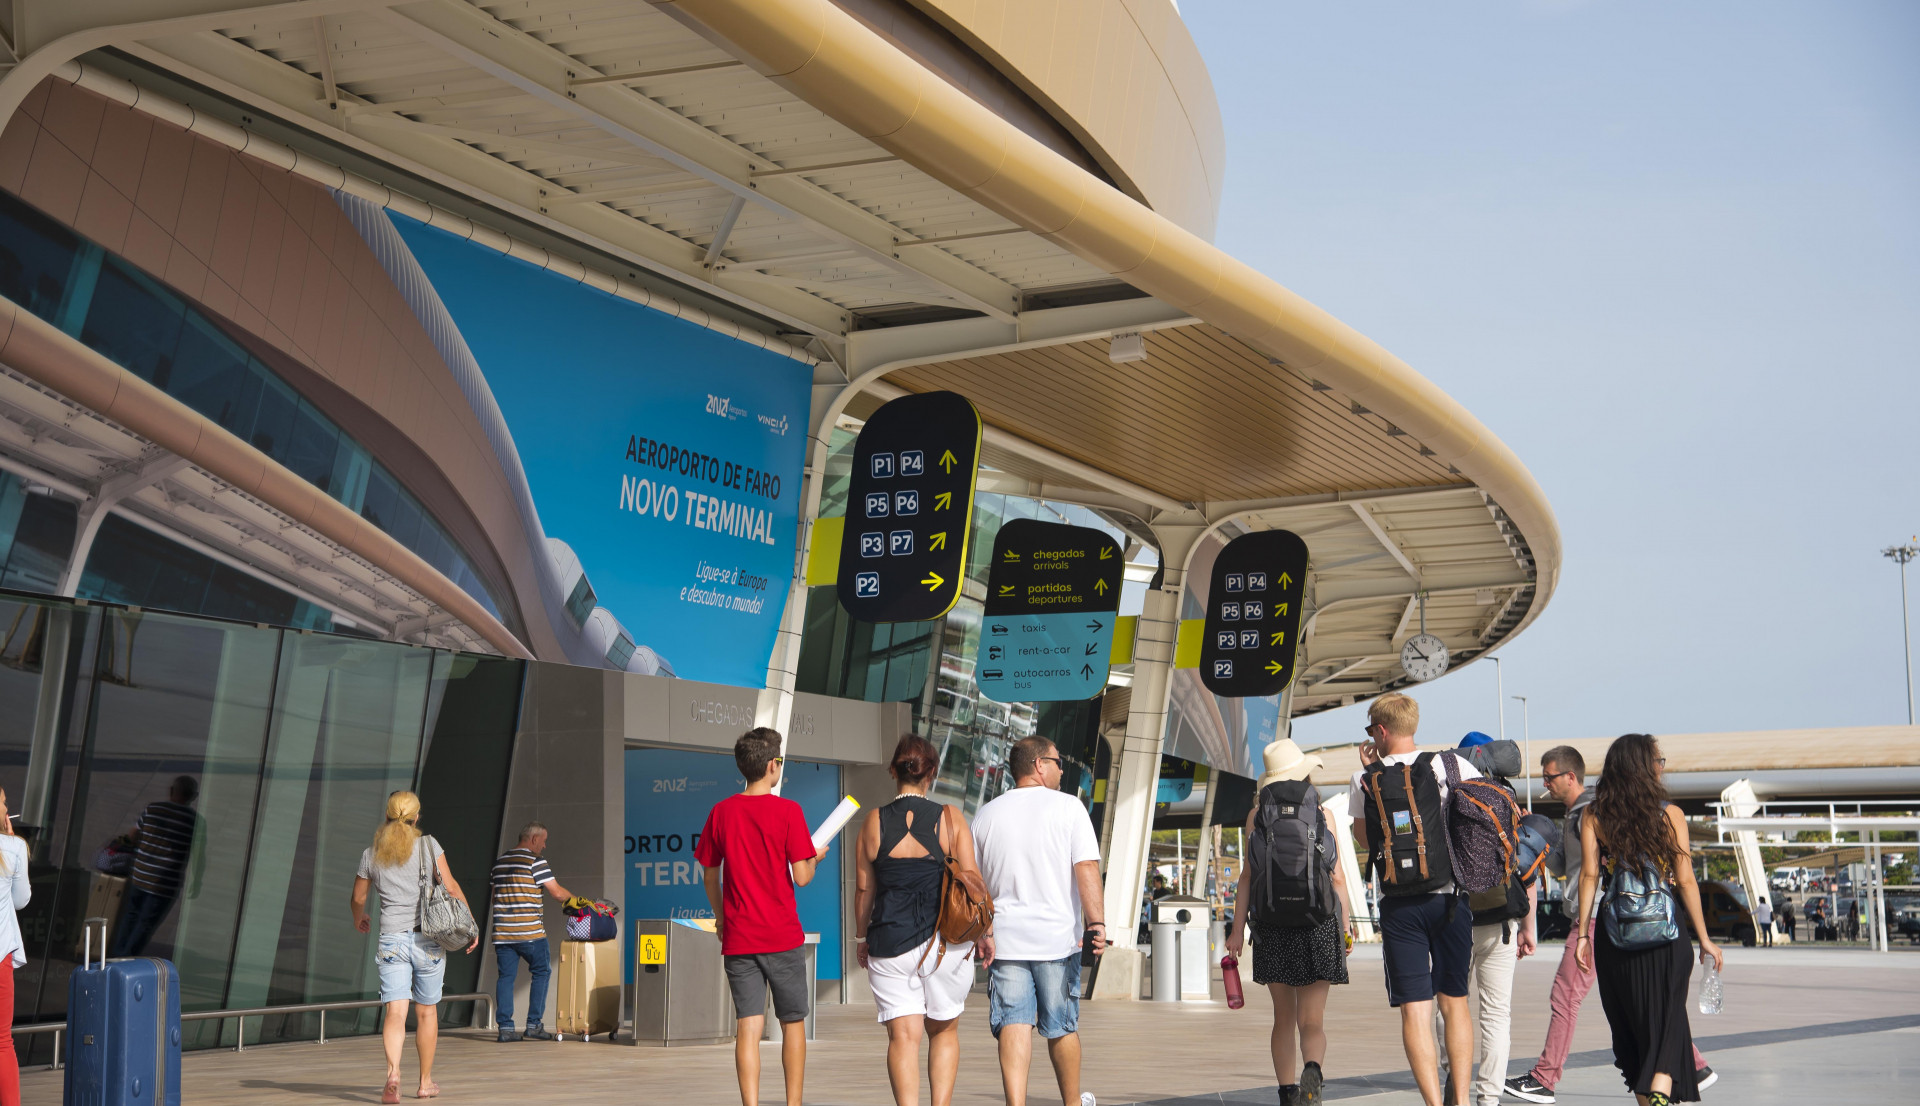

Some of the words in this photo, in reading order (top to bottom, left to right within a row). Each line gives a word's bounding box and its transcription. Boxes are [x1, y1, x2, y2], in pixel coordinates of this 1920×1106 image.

[757, 414, 779, 428] VINCI
[625, 434, 720, 484] AEROPORTO
[723, 461, 741, 490] DE
[745, 467, 781, 500] FARO
[874, 457, 893, 474] P1
[902, 455, 922, 472] P4
[619, 474, 679, 522] NOVO
[685, 490, 775, 546] TERMINAL
[867, 497, 888, 513] P5
[896, 495, 917, 511] P6
[862, 537, 883, 552] P3
[891, 535, 912, 550] P7
[1033, 549, 1085, 561] chegadas
[1033, 561, 1069, 571] arrivals
[696, 560, 731, 584] Ligue-se
[731, 566, 738, 585] à
[738, 570, 768, 593] Europa
[1228, 576, 1241, 588] P1
[1250, 576, 1265, 588] P4
[857, 577, 878, 593] P2
[1028, 583, 1072, 595] partidas
[680, 586, 687, 600] e
[687, 583, 725, 608] descubra
[725, 595, 732, 609] o
[732, 595, 765, 615] mundo!
[1028, 594, 1083, 606] departures
[1223, 605, 1239, 617] P5
[1246, 605, 1261, 616] P6
[1022, 623, 1047, 633] taxis
[1219, 634, 1235, 646] P3
[1242, 634, 1258, 645] P7
[1018, 646, 1071, 656] rent-a-car
[1013, 668, 1071, 678] autocarros
[1215, 663, 1231, 675] P2
[1014, 680, 1032, 689] bus
[690, 699, 753, 728] CHEGADAS
[790, 712, 814, 735] VALS
[624, 833, 683, 854] ORTO
